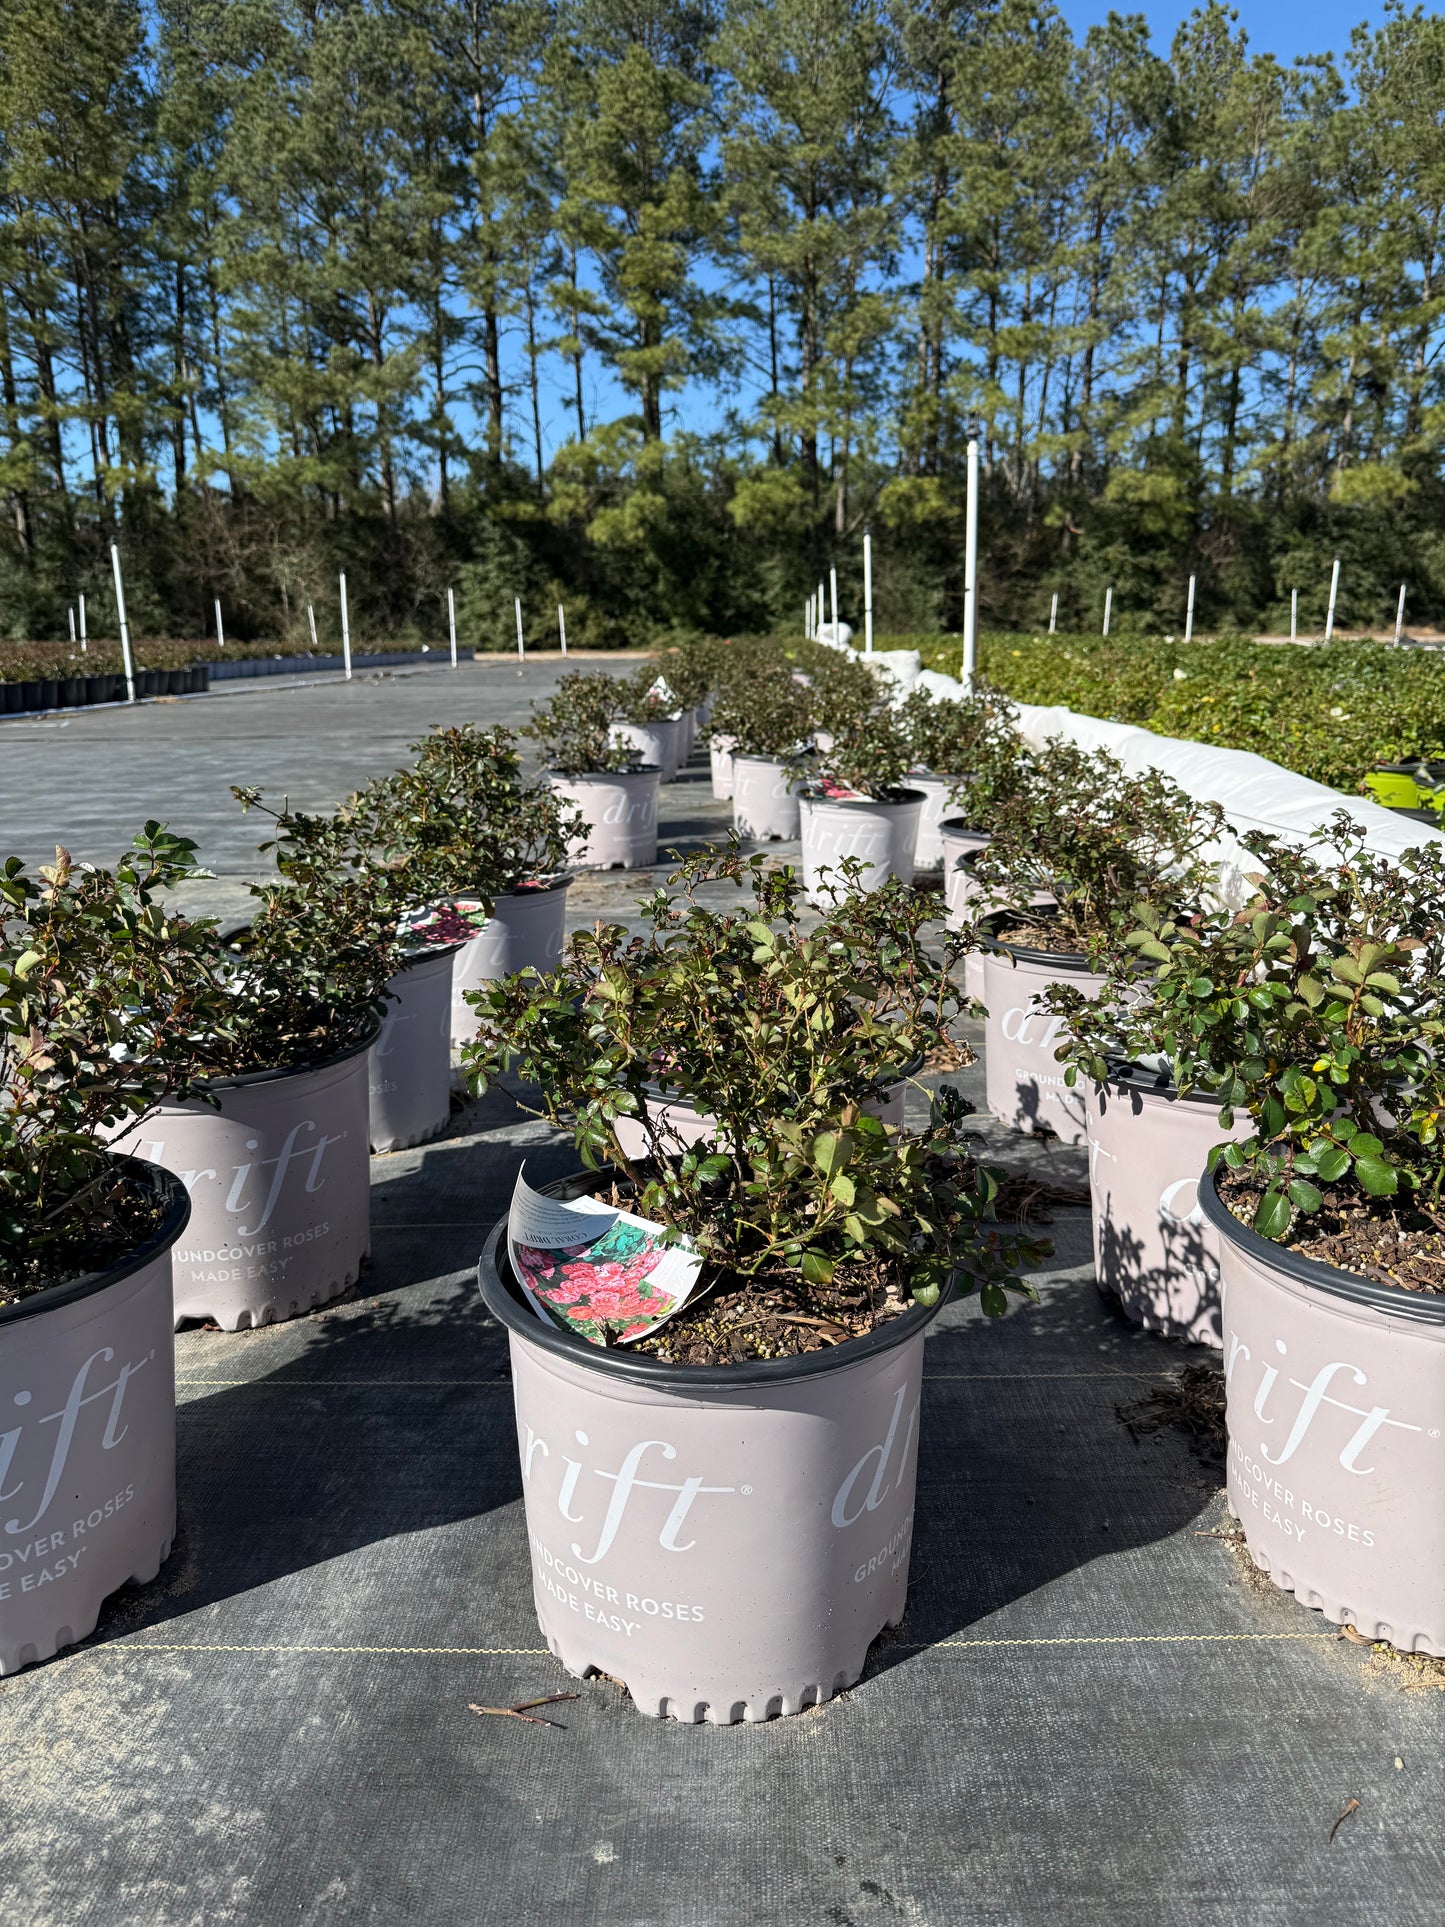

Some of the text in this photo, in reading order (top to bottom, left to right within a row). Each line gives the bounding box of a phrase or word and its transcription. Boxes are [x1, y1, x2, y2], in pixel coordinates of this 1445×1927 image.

[1015, 1068, 1086, 1090] GROUNDO
[144, 1120, 342, 1237] rift
[283, 1221, 330, 1250] ROSES
[551, 1232, 588, 1244] CORAL
[191, 1258, 290, 1283] MADE EASY
[72, 1483, 136, 1538] ROSES
[1231, 1436, 1376, 1548] NDCOVER ROSES
[1231, 1461, 1306, 1543] MADE EASY
[20, 1550, 84, 1593] EASY
[854, 1514, 913, 1583] GROUND
[537, 1564, 634, 1637] MADE EASY
[626, 1592, 705, 1623] ROSES
